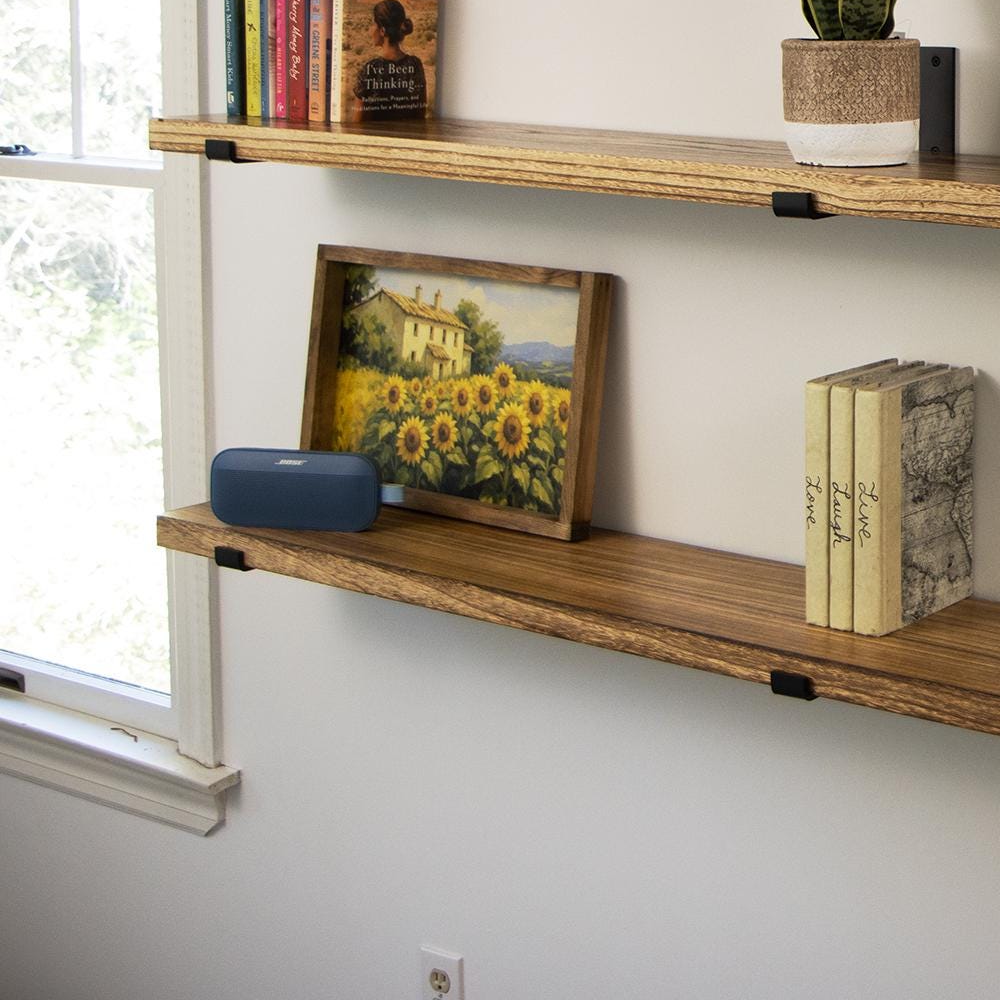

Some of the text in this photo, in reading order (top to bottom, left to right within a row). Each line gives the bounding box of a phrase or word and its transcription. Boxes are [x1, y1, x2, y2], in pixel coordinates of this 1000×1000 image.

[289, 25, 303, 53] Money
[312, 30, 320, 60] GREENE
[290, 55, 301, 81] Baby
[312, 63, 320, 92] STREET
[366, 63, 415, 75] I've Been
[366, 78, 424, 93] Thinking...
[805, 475, 822, 530] Love
[829, 481, 851, 549] Laugh
[858, 481, 879, 548] Live
